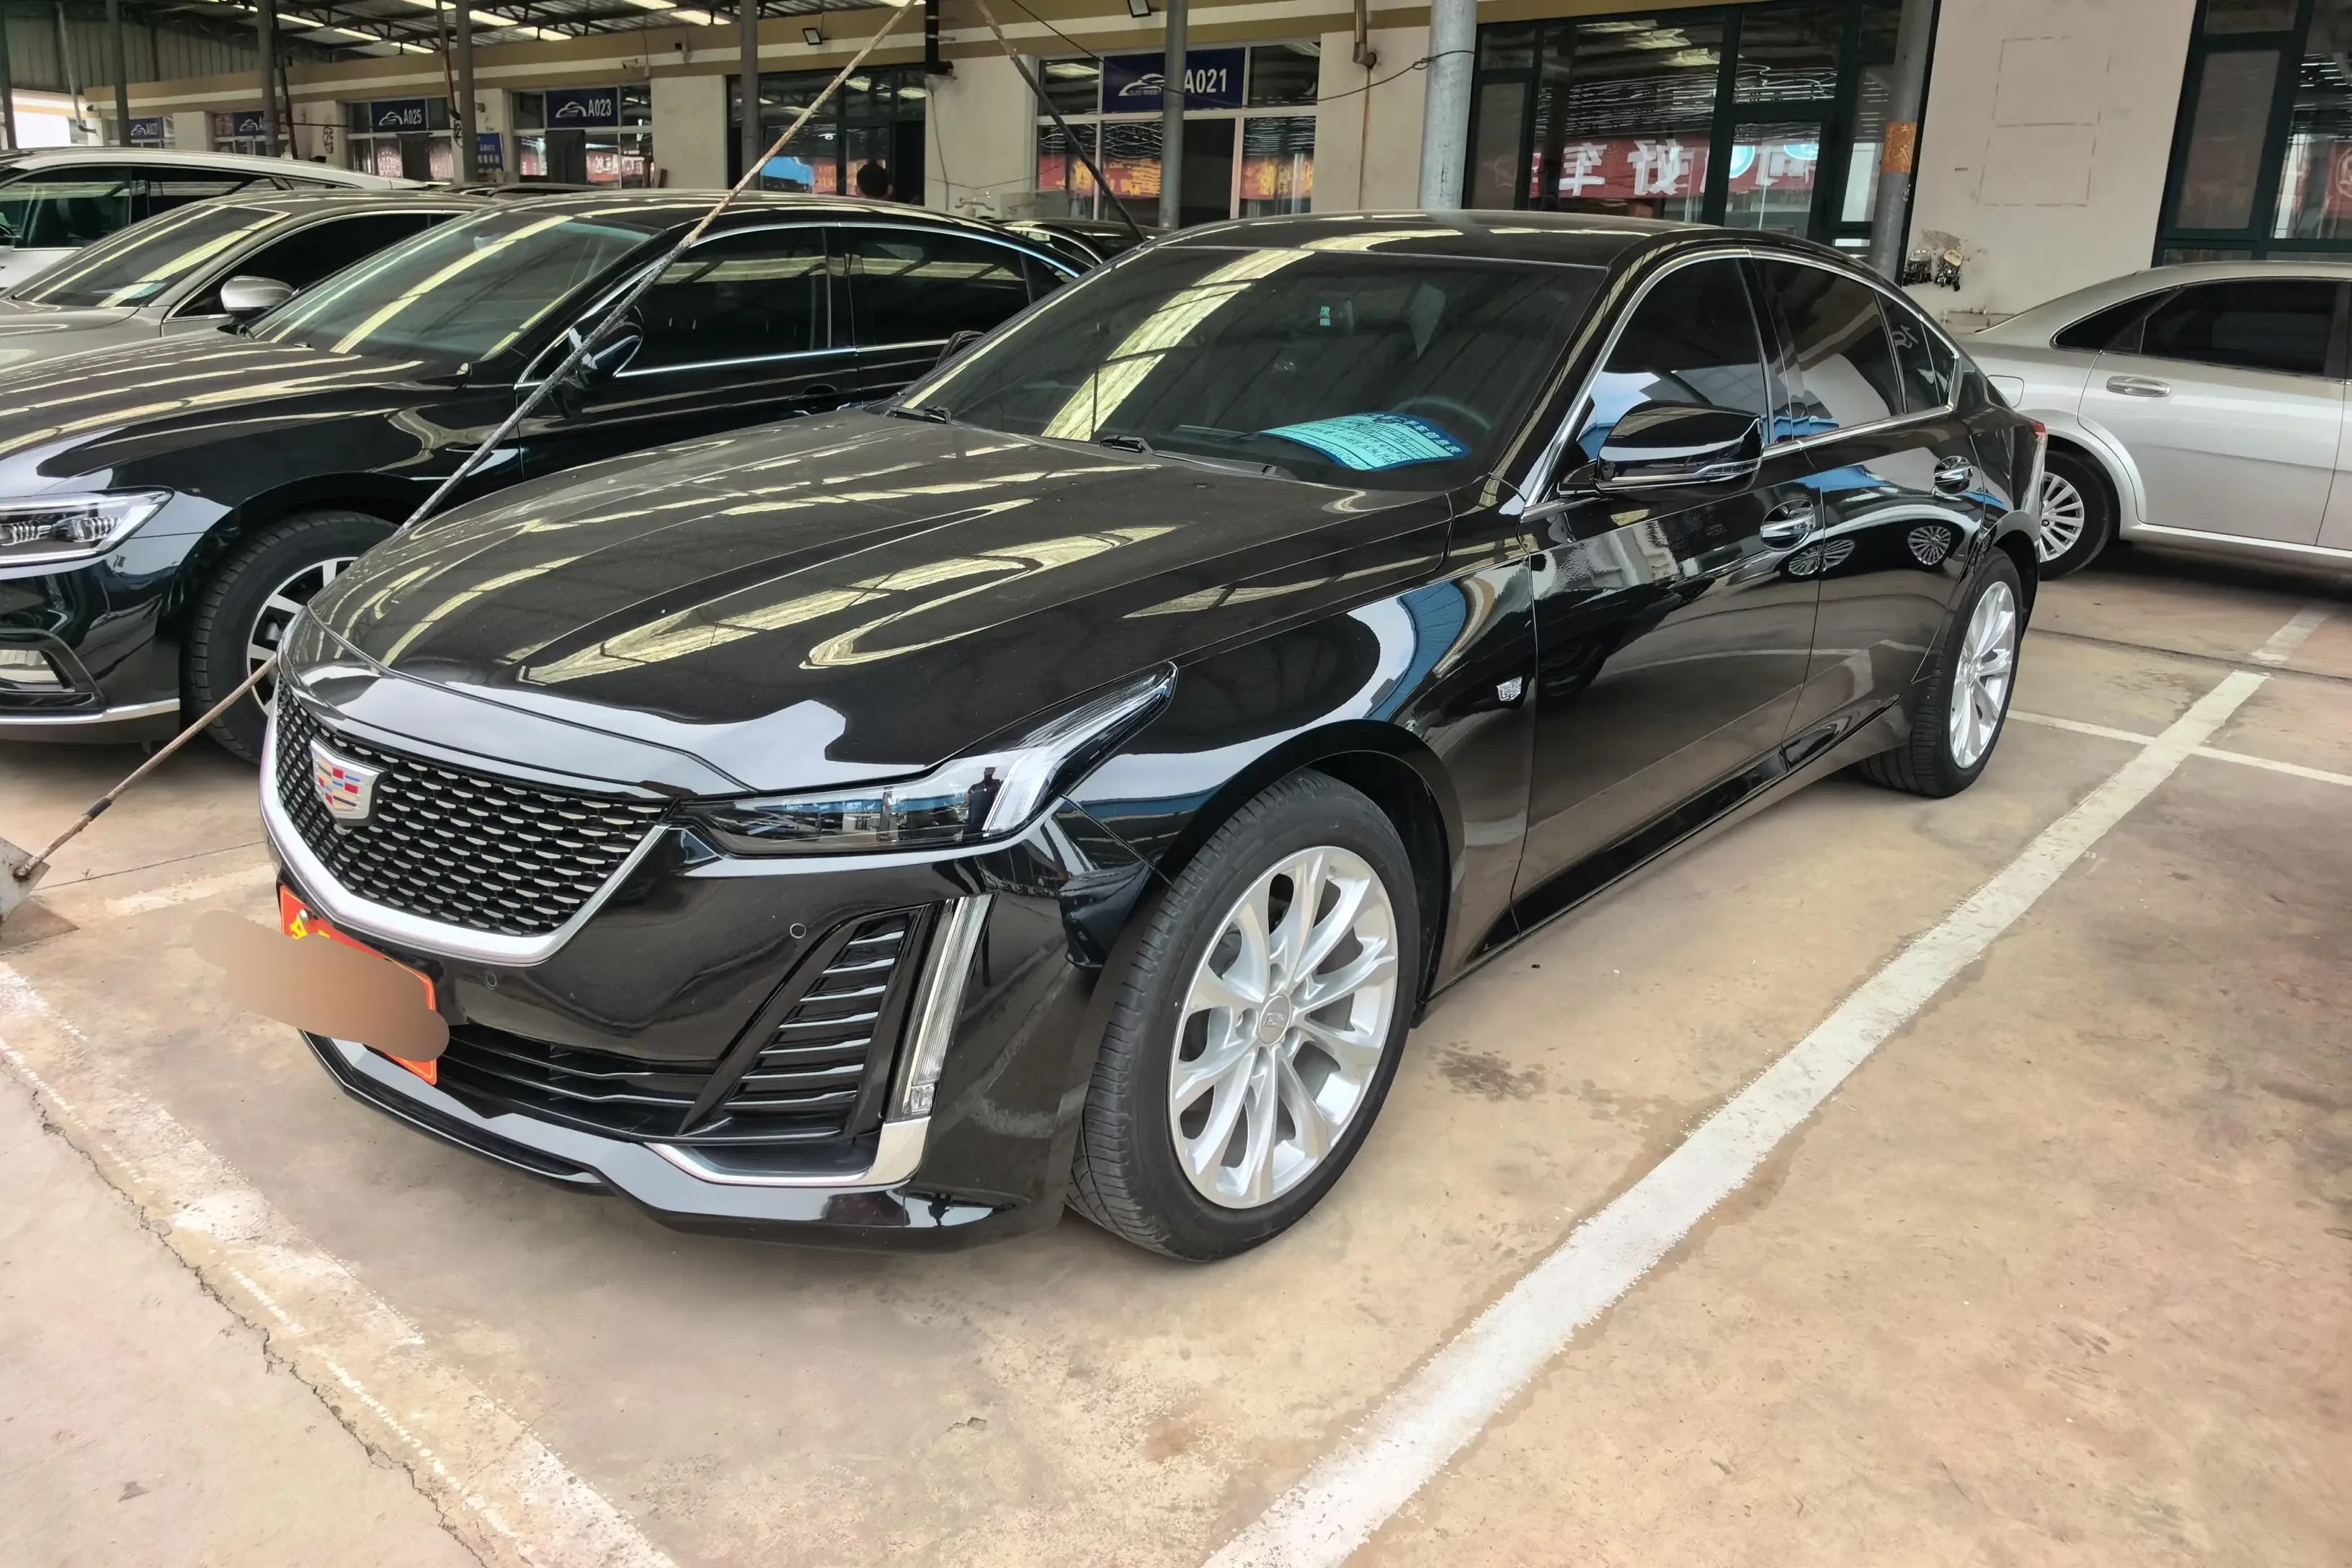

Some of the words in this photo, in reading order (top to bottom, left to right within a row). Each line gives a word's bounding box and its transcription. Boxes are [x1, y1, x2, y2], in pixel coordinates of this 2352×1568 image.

[1184, 68, 1226, 94] A021
[404, 109, 422, 125] A025
[588, 99, 612, 117] A023
